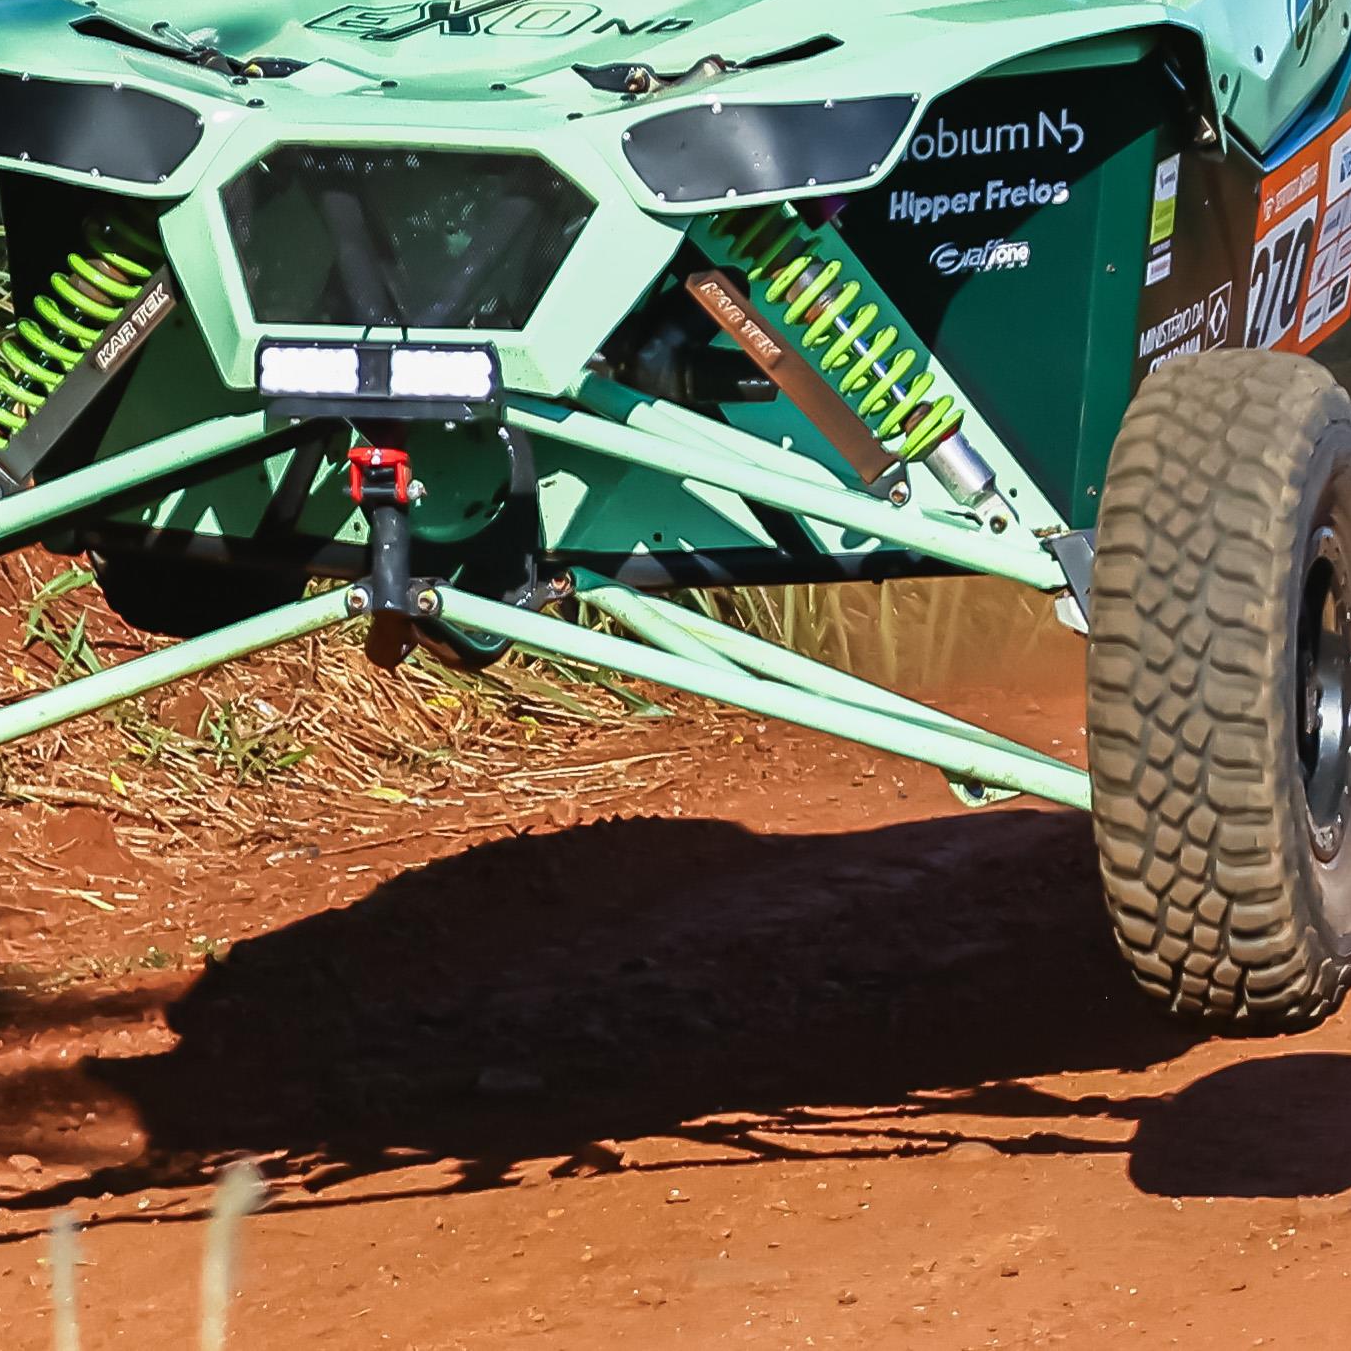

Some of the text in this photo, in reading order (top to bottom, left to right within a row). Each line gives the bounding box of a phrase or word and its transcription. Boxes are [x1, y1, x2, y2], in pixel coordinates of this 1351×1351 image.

[889, 177, 1070, 225] Hipper Freios
[97, 281, 170, 369] KAR TEK
[1246, 217, 1314, 349] 270
